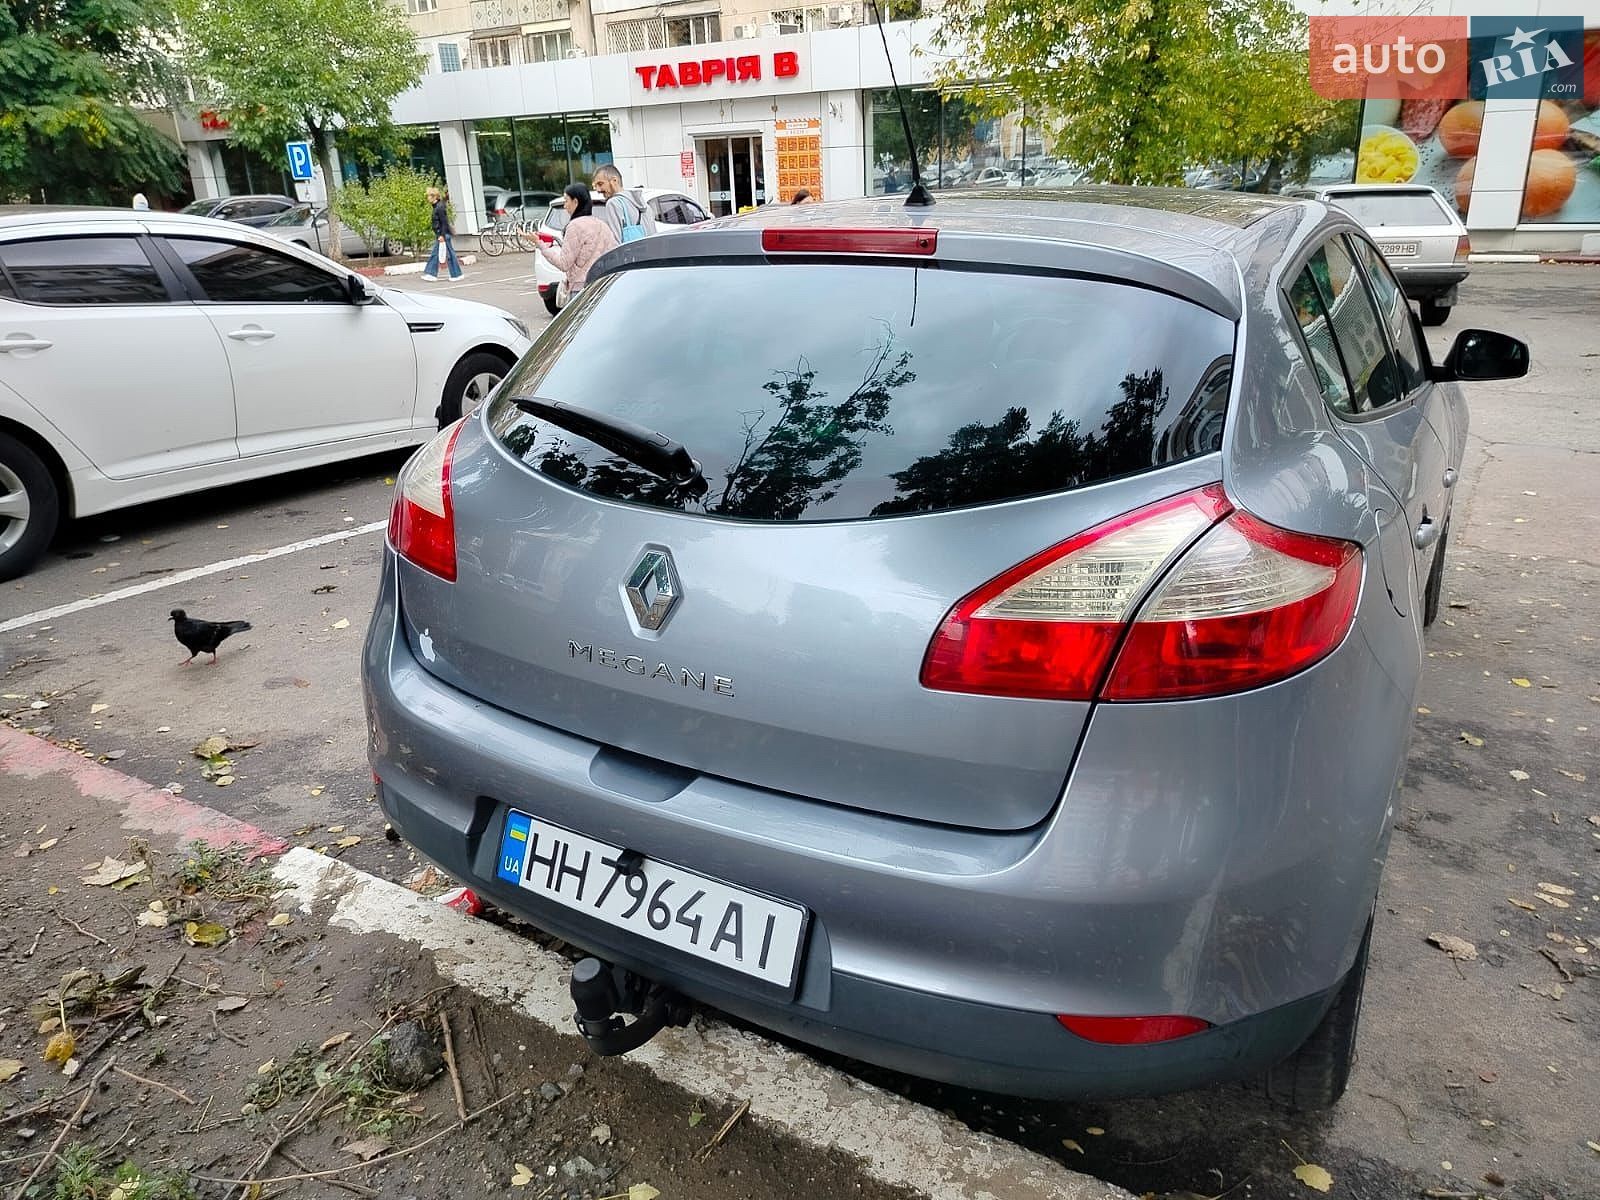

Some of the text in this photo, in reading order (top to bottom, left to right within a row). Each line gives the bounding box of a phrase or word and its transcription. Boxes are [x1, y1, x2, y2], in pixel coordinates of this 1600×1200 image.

[635, 54, 761, 89] ТАВРІЯ
[293, 146, 306, 176] P
[568, 639, 735, 698] MEGANE
[504, 856, 520, 876] UA
